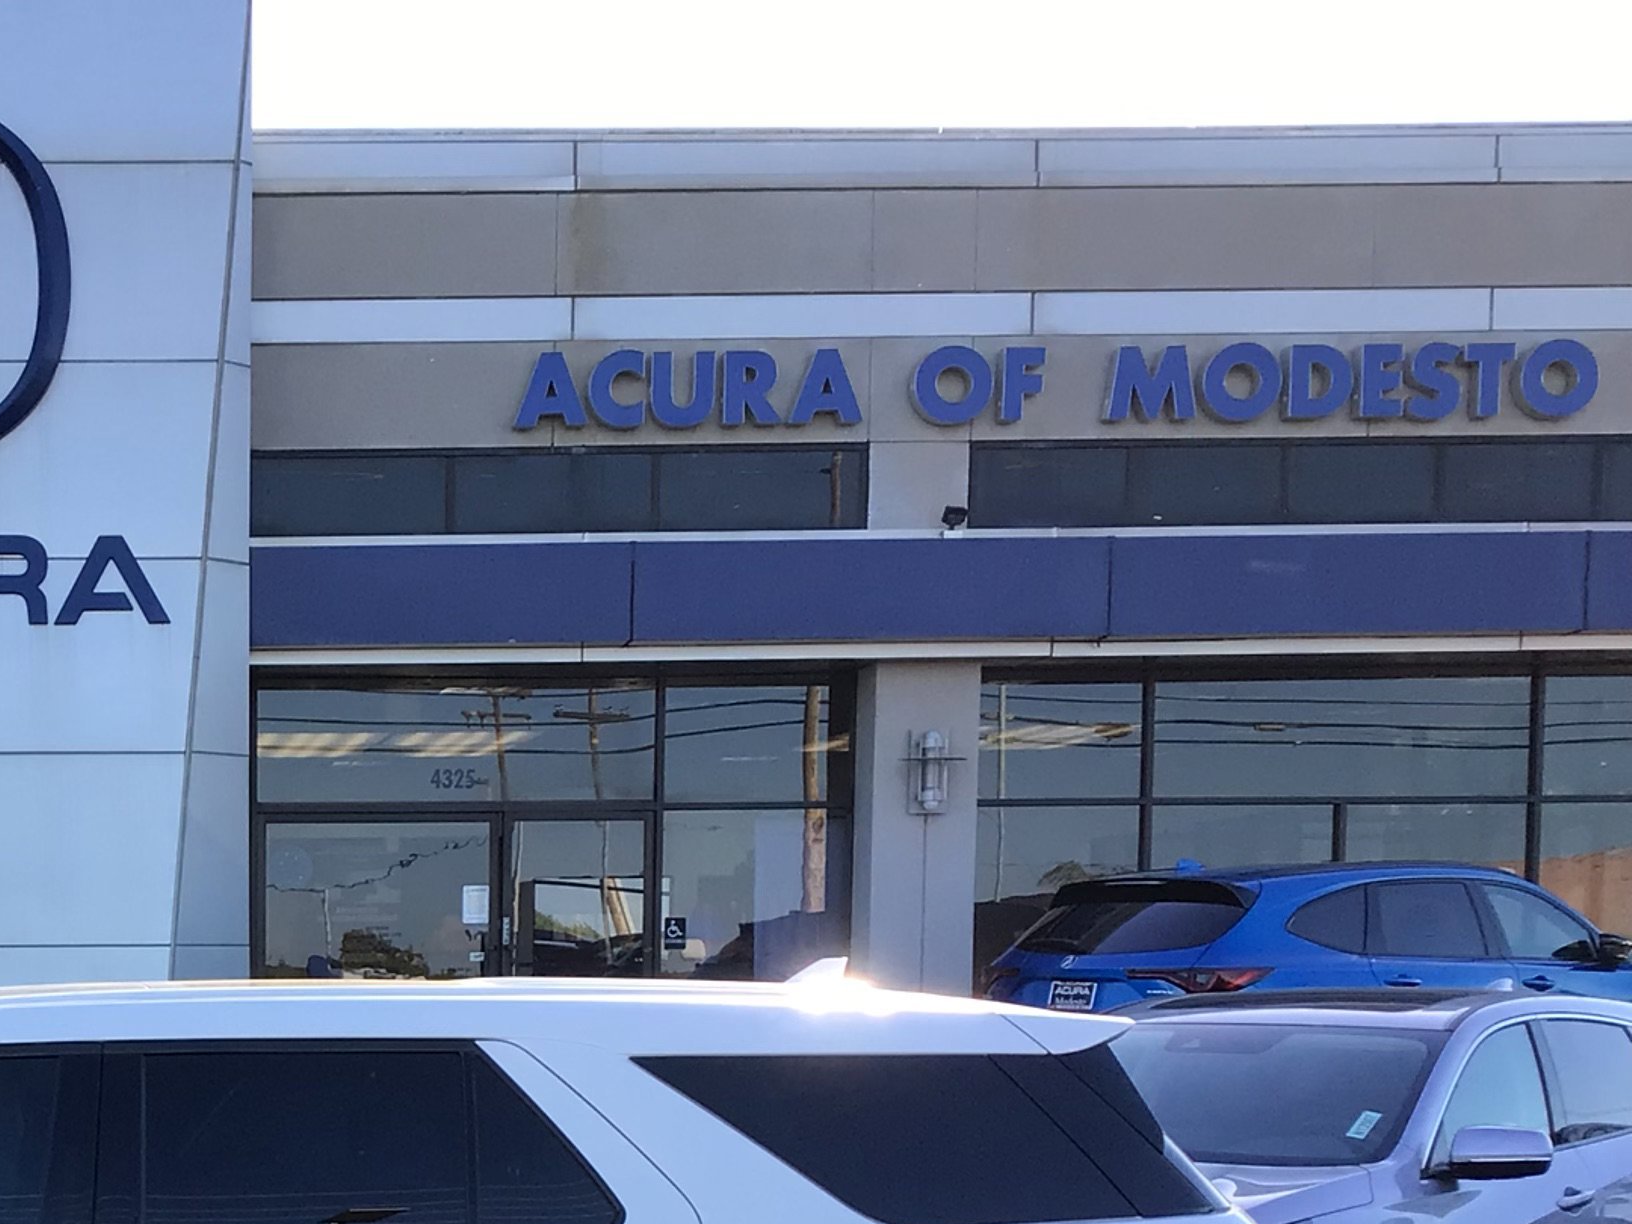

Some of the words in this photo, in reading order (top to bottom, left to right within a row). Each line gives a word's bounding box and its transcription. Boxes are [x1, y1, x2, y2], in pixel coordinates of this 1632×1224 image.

[512, 347, 864, 429] ACURA
[909, 344, 1047, 426] OF
[1100, 338, 1600, 424] MODESTO
[430, 768, 476, 789] 4325
[1054, 986, 1090, 995] ACURA
